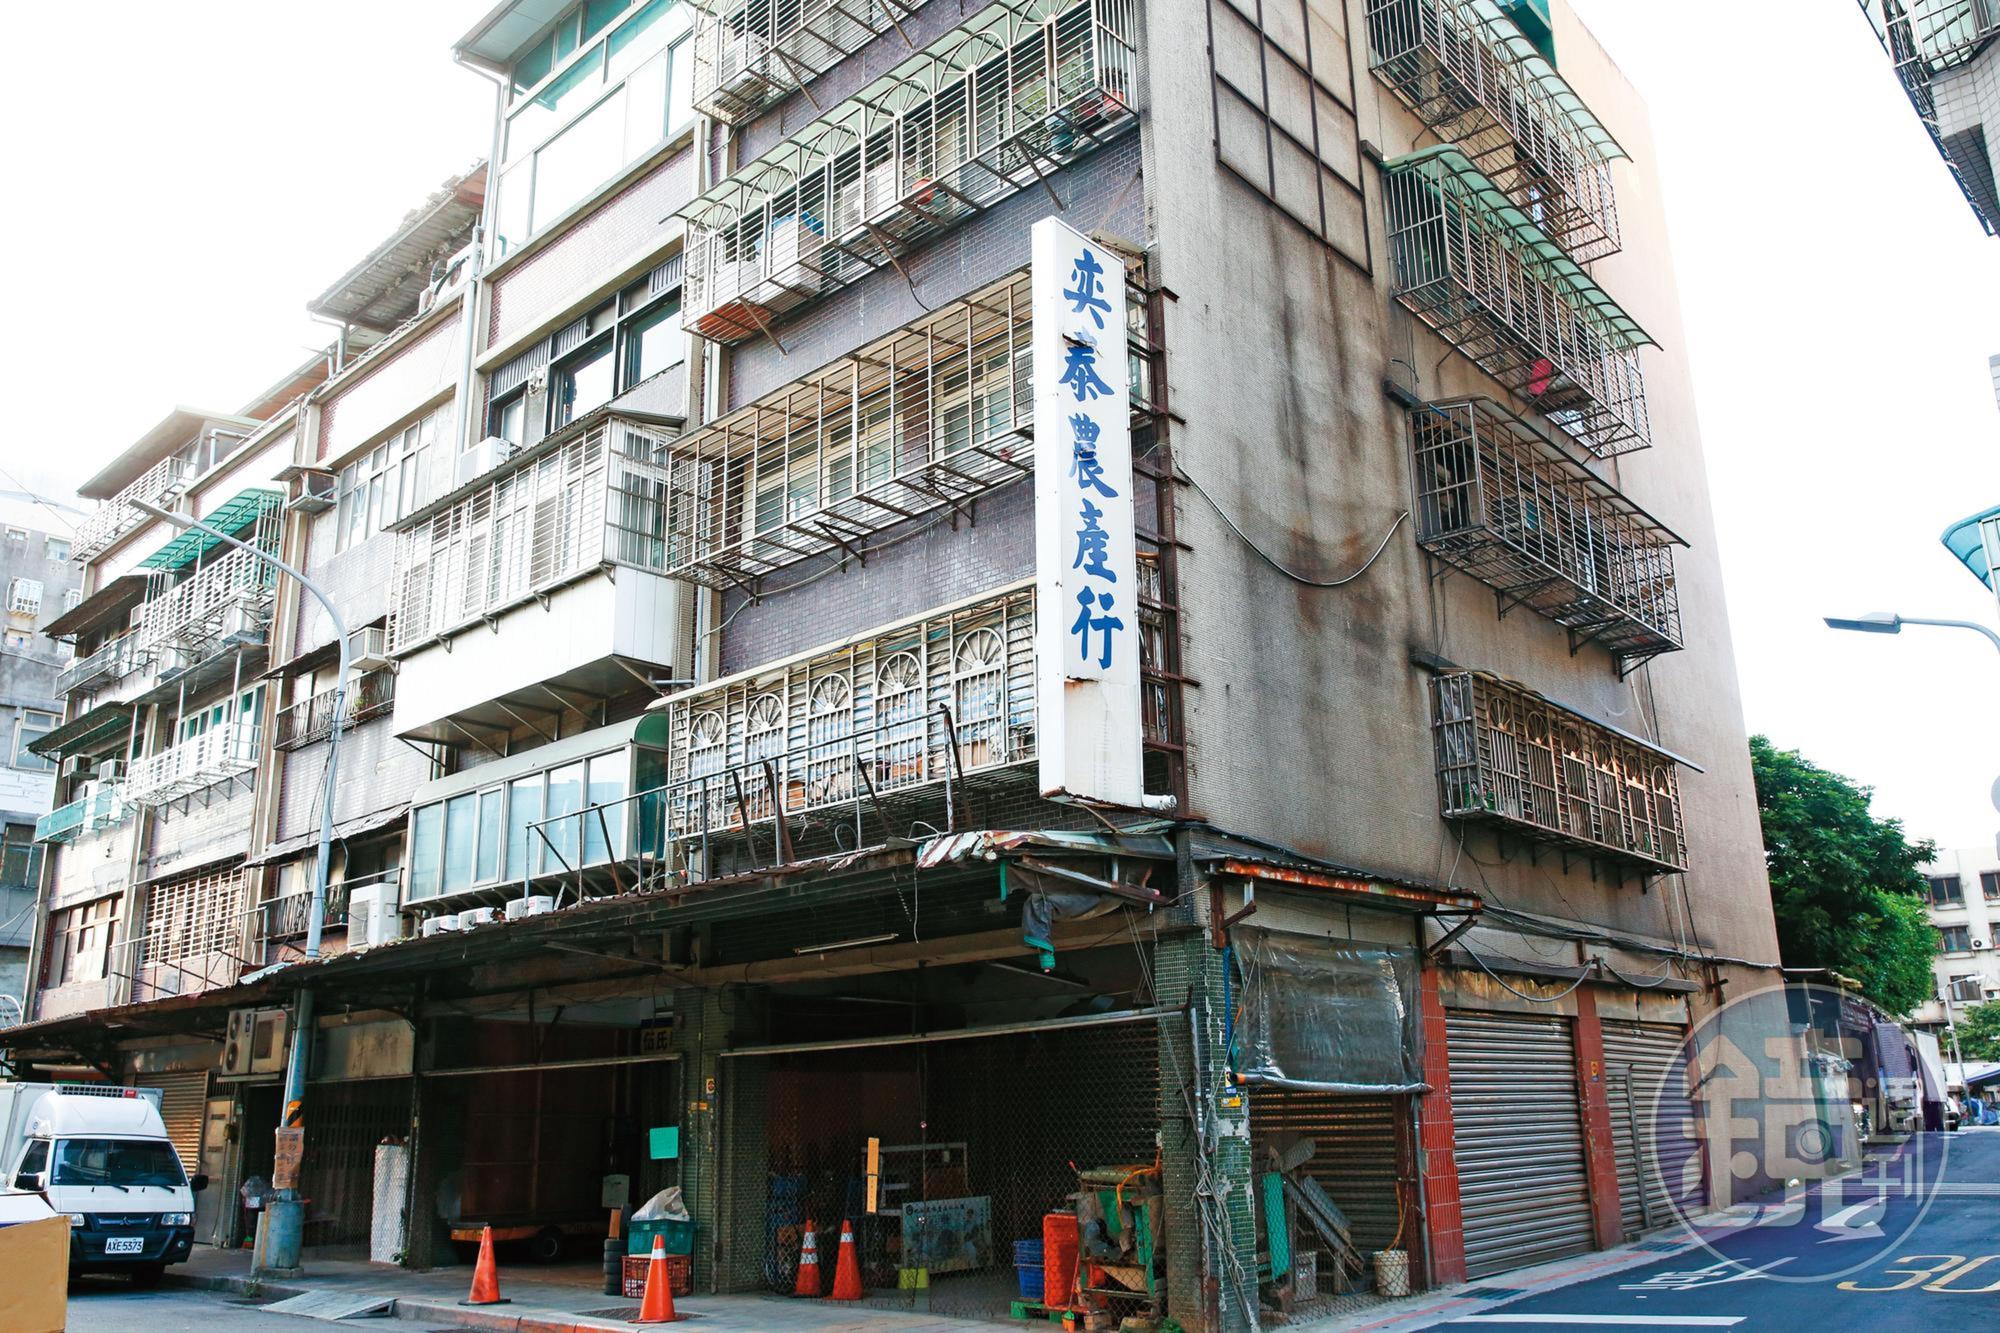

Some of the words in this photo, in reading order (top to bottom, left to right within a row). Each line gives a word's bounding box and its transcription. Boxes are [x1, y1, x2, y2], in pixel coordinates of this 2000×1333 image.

[1058, 247, 1125, 669] 奕泰農產行
[1836, 1255, 2000, 1293] 30
